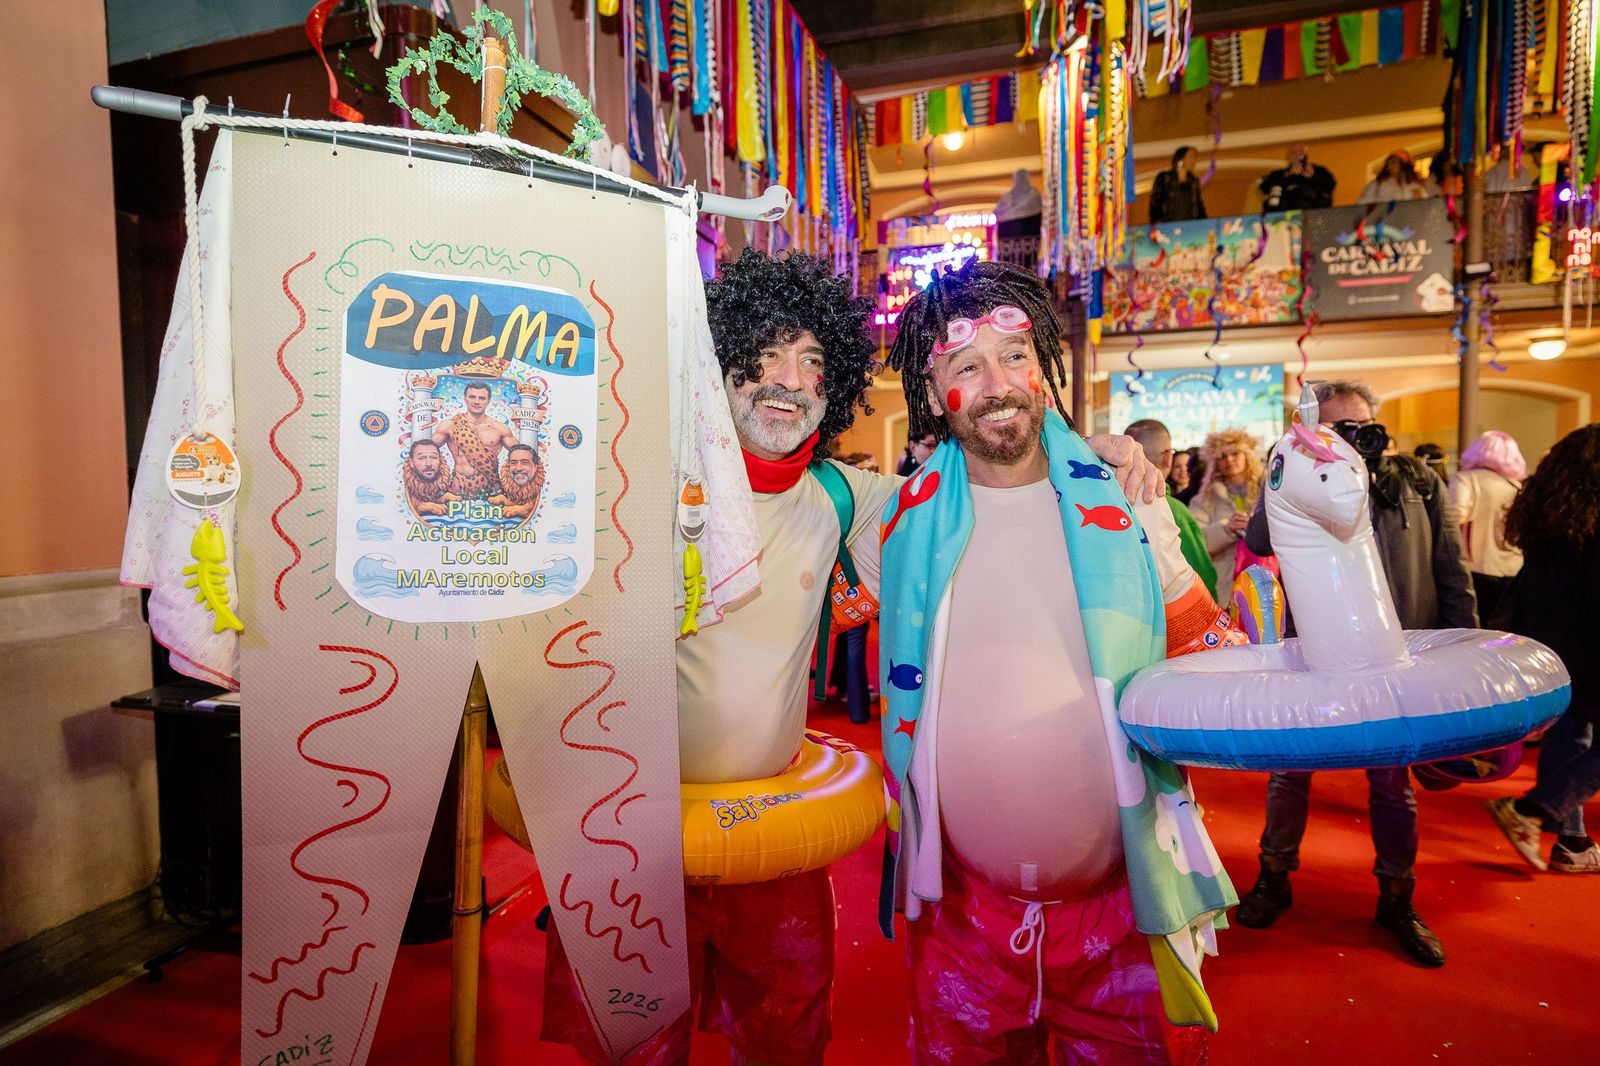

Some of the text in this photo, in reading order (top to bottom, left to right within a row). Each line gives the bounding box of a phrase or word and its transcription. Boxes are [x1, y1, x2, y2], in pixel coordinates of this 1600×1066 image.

[364, 283, 581, 368] PALMA
[1139, 388, 1252, 407] CARNAVAL
[417, 414, 429, 422] DE
[521, 420, 539, 429] 2026
[447, 500, 504, 519] Plan
[407, 522, 537, 544] Actuación
[441, 546, 509, 565] Local
[396, 569, 546, 588] MAremotos
[439, 589, 479, 597] Ayuntamiento
[608, 988, 664, 1011] 2026
